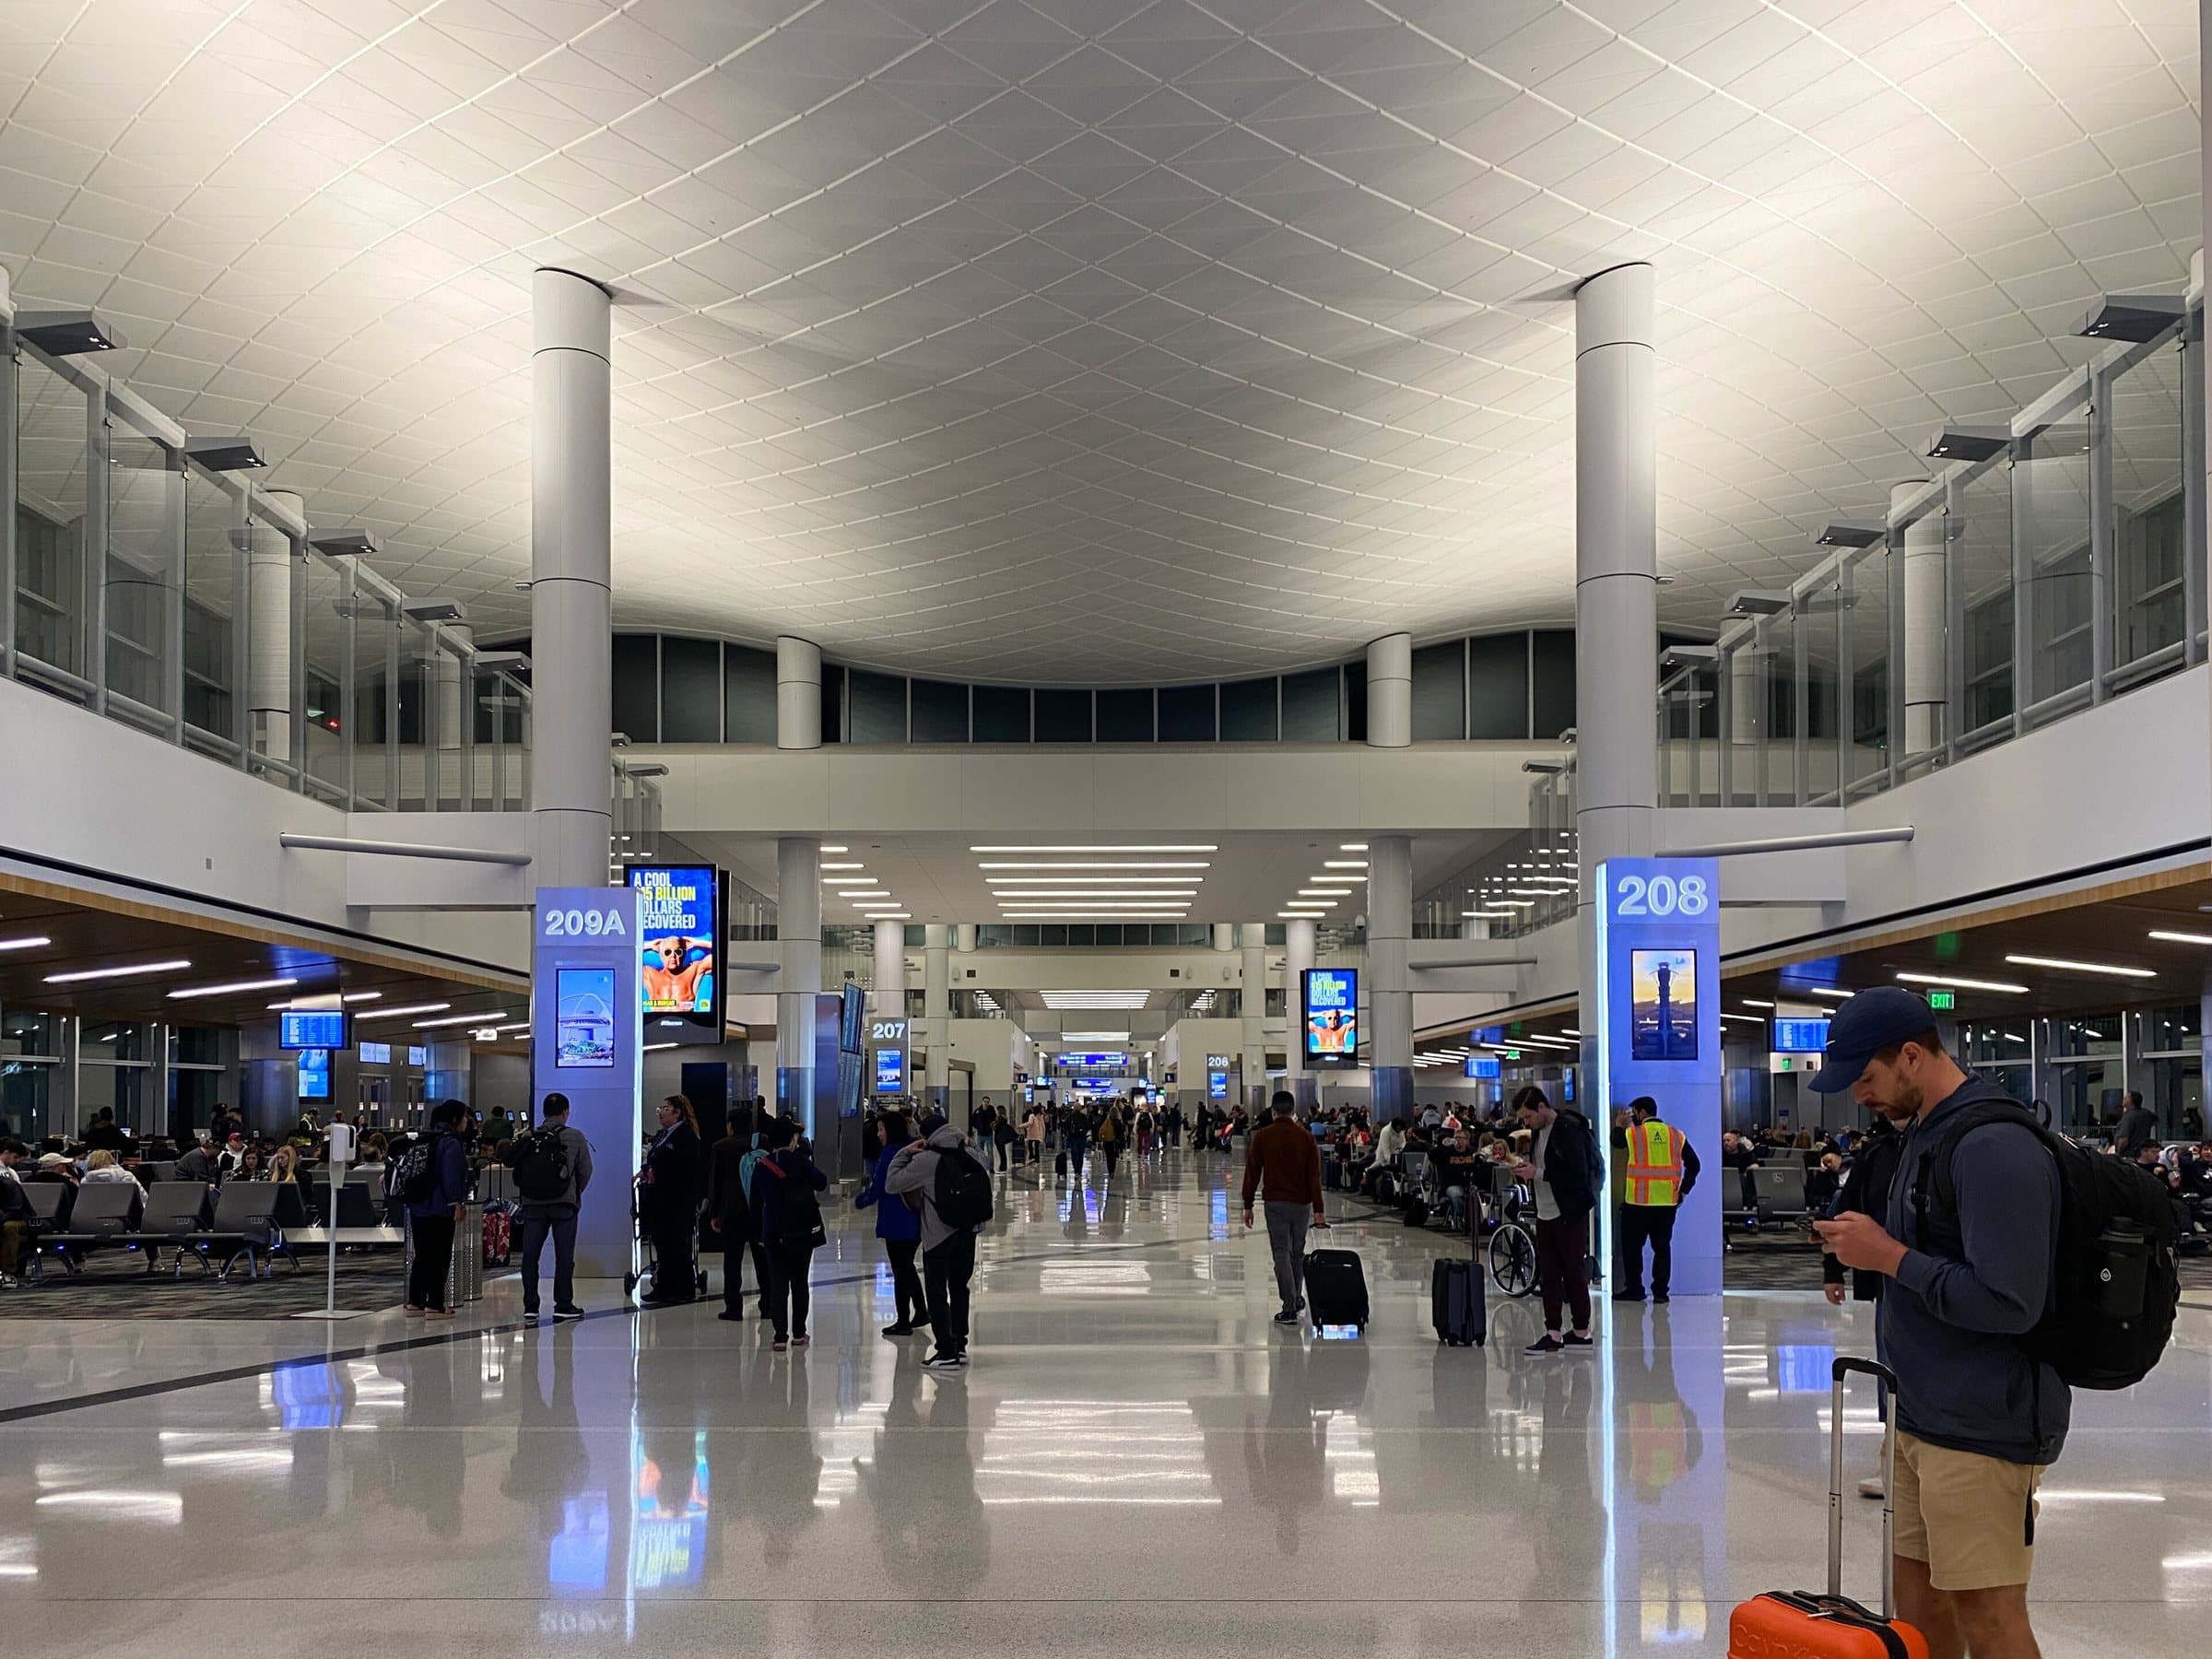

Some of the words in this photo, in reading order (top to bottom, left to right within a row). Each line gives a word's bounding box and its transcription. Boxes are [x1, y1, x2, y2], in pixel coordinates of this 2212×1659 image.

[634, 872, 642, 887] A
[644, 872, 673, 887] COOL
[655, 886, 696, 901] BILLION
[1618, 876, 1708, 915] 208
[643, 900, 683, 914] OLLARS
[545, 910, 626, 935] 209A
[643, 913, 696, 929] ECOVERED
[1931, 994, 1951, 1008] EXIT
[873, 1023, 905, 1039] 207
[1208, 1056, 1229, 1066] 206
